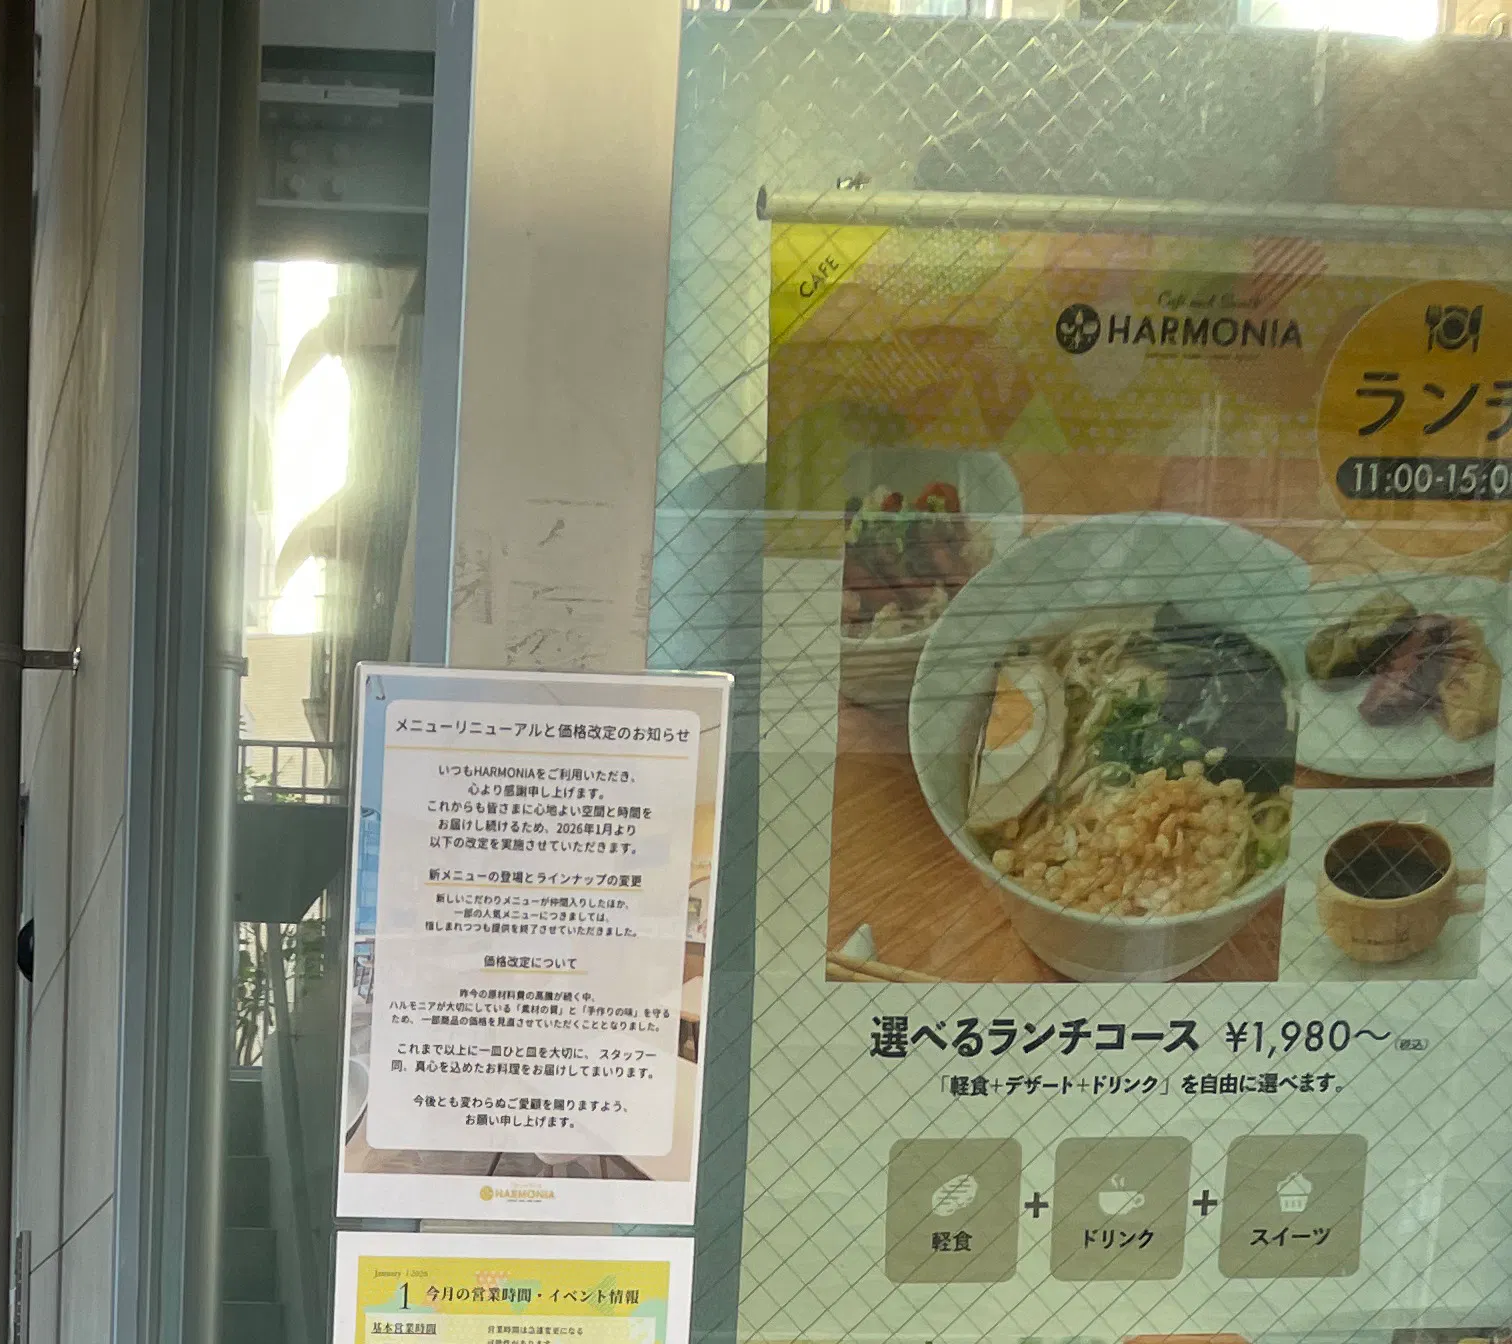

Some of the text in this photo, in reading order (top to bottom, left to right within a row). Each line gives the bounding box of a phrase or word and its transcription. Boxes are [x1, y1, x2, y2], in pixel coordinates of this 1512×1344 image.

[799, 254, 840, 299] CAFE
[1107, 314, 1303, 349] HARMONIA
[1352, 462, 1512, 494] 11:00-15:0
[396, 719, 690, 743] メニューリニューアルと価格改定のお知らせ
[484, 955, 577, 970] 価格改定について
[870, 1015, 1201, 1058] 選べるランチコース
[930, 1230, 974, 1253] 軽食
[1082, 1226, 1155, 1251] ドリンク
[1249, 1225, 1331, 1249] スイーツ
[399, 1282, 412, 1310] 1
